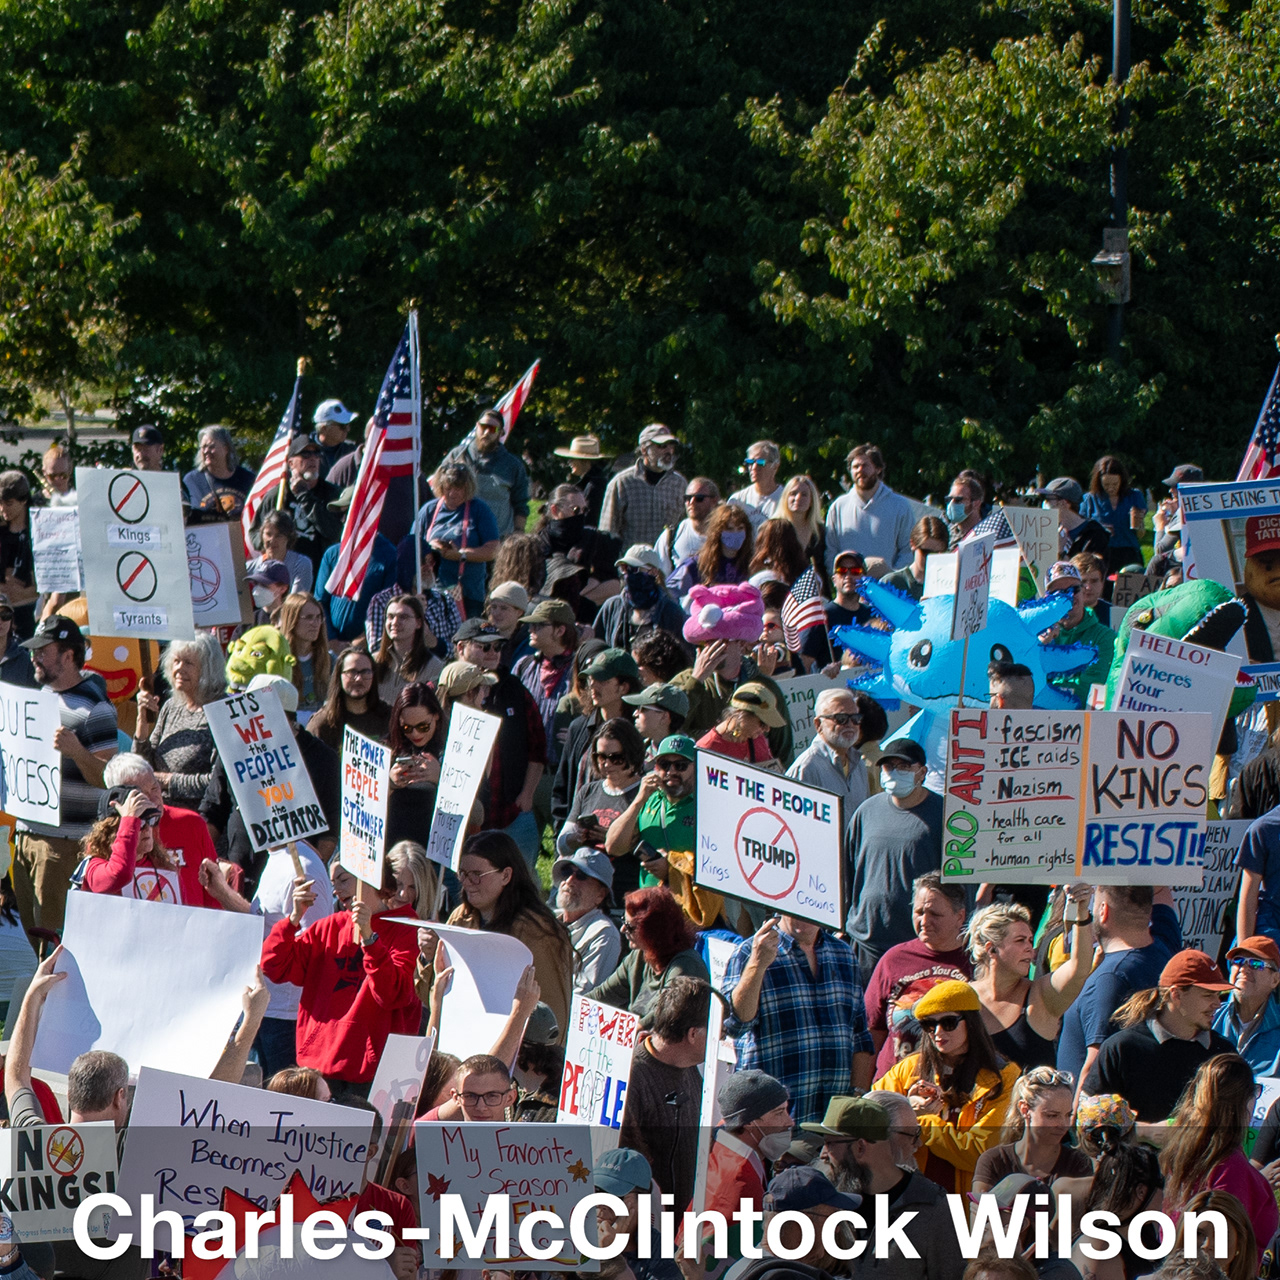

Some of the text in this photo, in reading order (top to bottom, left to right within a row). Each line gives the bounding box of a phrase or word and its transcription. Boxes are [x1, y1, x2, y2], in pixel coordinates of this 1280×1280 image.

[117, 528, 151, 544] Kings
[119, 612, 162, 626] Tyrants
[1140, 634, 1210, 666] HELLO!
[234, 715, 272, 745] WE
[1002, 716, 1081, 742] fascism
[1116, 718, 1179, 761] NO
[234, 744, 296, 783] PEOPLE
[248, 742, 267, 755] the
[345, 731, 385, 769] THE POWER
[1000, 744, 1079, 768] ICE raids
[258, 782, 294, 807] YOU
[345, 767, 379, 801] PEOPLE
[706, 766, 831, 824] WE THE PEOPLE
[997, 778, 1061, 799] Nazism
[1091, 763, 1206, 815] KINGS
[250, 803, 327, 847] DICTATOR
[343, 797, 383, 839] STRONGER
[992, 810, 1065, 828] health care
[742, 836, 795, 869] TRUMP
[998, 830, 1042, 844] for all
[1082, 822, 1205, 867] RESIST!!
[991, 852, 1075, 872] human rights
[796, 891, 835, 914] Crowns
[579, 998, 635, 1049] POWER
[559, 1059, 627, 1130] PEOPLE
[179, 1089, 368, 1162] When Injustice
[190, 1139, 288, 1180] Becomes
[481, 1168, 567, 1195] Season
